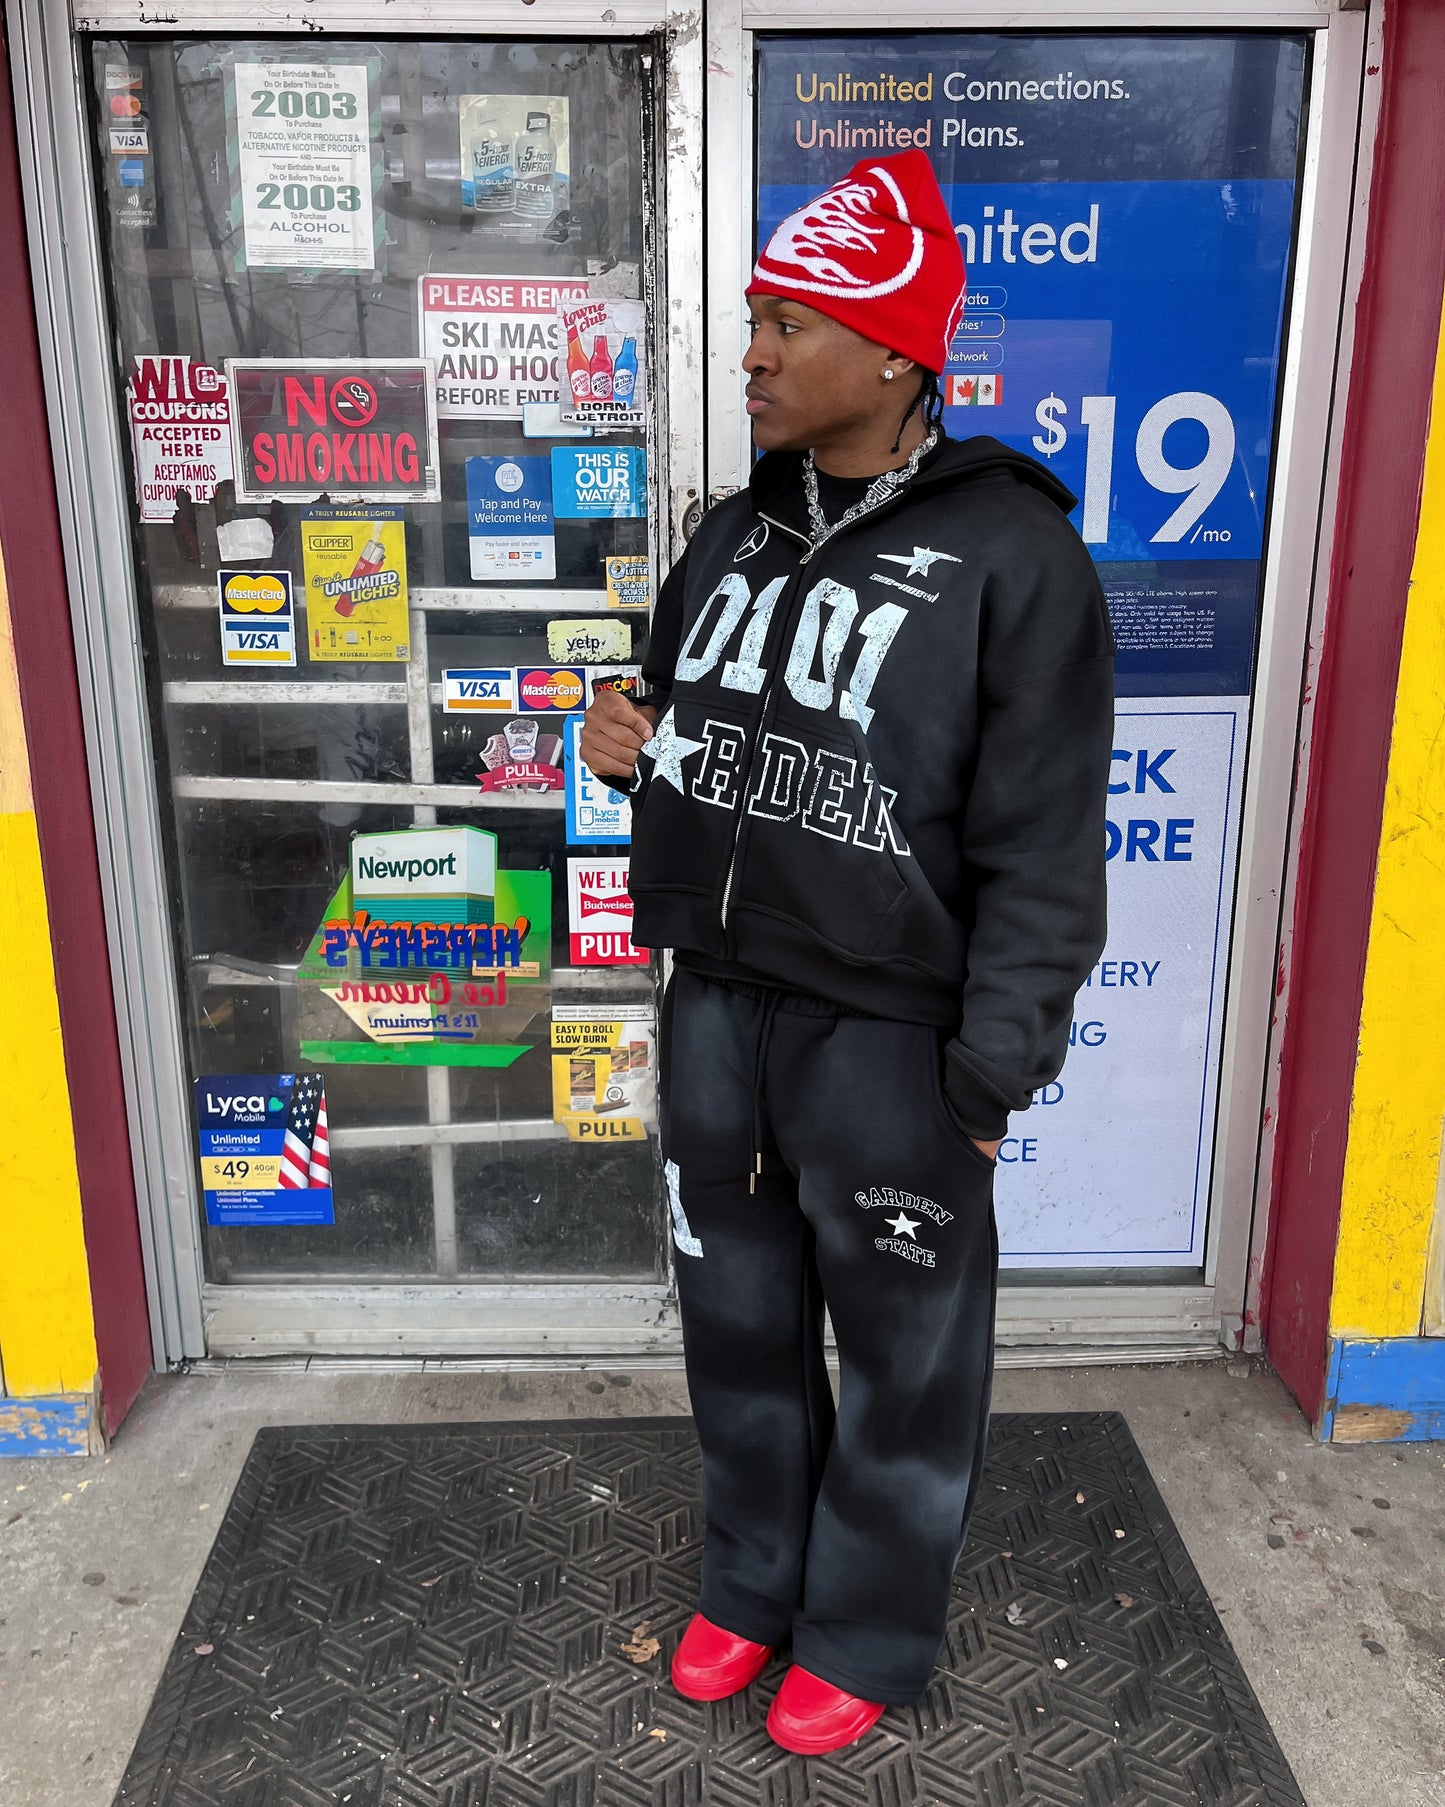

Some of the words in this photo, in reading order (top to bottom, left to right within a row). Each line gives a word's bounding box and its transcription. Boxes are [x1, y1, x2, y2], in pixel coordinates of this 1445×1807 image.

[267, 70, 281, 78] Your
[282, 70, 310, 78] Birthdate
[311, 70, 326, 78] Must
[327, 70, 336, 78] Be
[796, 72, 932, 102] Unlimited
[943, 72, 1130, 102] Connections.
[251, 90, 357, 120] 2003
[285, 120, 293, 128] To
[294, 120, 322, 128] Purchase
[116, 135, 143, 146] VISA
[248, 132, 286, 140] TOBACCO,
[287, 132, 312, 140] VAPOR
[313, 133, 353, 142] PRODUCTS
[354, 134, 359, 142] &
[796, 120, 931, 148] Unlimited
[943, 120, 1024, 148] Plans.
[242, 142, 290, 151] ALTERNATIVE
[292, 143, 326, 152] NICOTINE
[327, 144, 366, 152] PRODUCTS
[479, 153, 510, 168] ENERGY
[521, 162, 552, 172] ENERGY
[516, 182, 552, 192] EXTRA
[256, 183, 361, 211] 2003
[116, 208, 153, 217] Contactless
[290, 212, 298, 220] To
[299, 212, 327, 220] Purchase
[120, 218, 150, 226] Accepted
[270, 222, 350, 233] ALCOHOL
[428, 284, 514, 307] PLEASE
[522, 287, 588, 308] REMO
[563, 303, 605, 328] towne
[580, 312, 607, 332] club
[442, 322, 488, 348] SKI
[438, 354, 498, 380] AND
[437, 388, 509, 406] BEFORE
[132, 402, 228, 420] COUPONS
[581, 402, 626, 411] BORN
[576, 413, 644, 421] DETROIT
[142, 427, 221, 441] ACCEPTED
[162, 444, 203, 457] HERE
[253, 432, 419, 483] SMOKING
[575, 454, 611, 467] THIS
[614, 453, 629, 466] IS
[154, 464, 216, 481] ACEPTAMOS
[576, 468, 629, 488] OUR
[144, 485, 192, 500] CUPONS
[196, 485, 208, 500] DE
[576, 489, 630, 501] WATCH
[480, 499, 498, 511] Tap
[501, 500, 520, 509] and
[524, 499, 542, 511] Pay
[475, 512, 520, 524] Welcome
[524, 513, 548, 522] Here
[312, 539, 349, 548] CLIPPER
[324, 572, 397, 596] UNLIMITED
[226, 589, 285, 600] MasterCard
[351, 584, 398, 603] LIGHTS
[238, 633, 280, 649] VISA
[566, 634, 600, 651] yelp
[458, 681, 500, 697] VISA
[522, 684, 581, 696] MasterCard
[505, 764, 544, 778] PULL
[595, 808, 620, 818] Lyca
[359, 852, 456, 882] Newport
[579, 872, 606, 888] WE
[584, 901, 634, 910] Budweiser
[580, 935, 640, 957] PULL
[556, 1035, 580, 1043] SLOW
[583, 1035, 607, 1043] BURN
[206, 1093, 265, 1116] Lyca
[234, 1113, 265, 1122] Mobile
[580, 1122, 632, 1137] PULL
[211, 1135, 260, 1144] Unlimited
[854, 1188, 954, 1226] GARDEN
[875, 1238, 936, 1268] STATE
